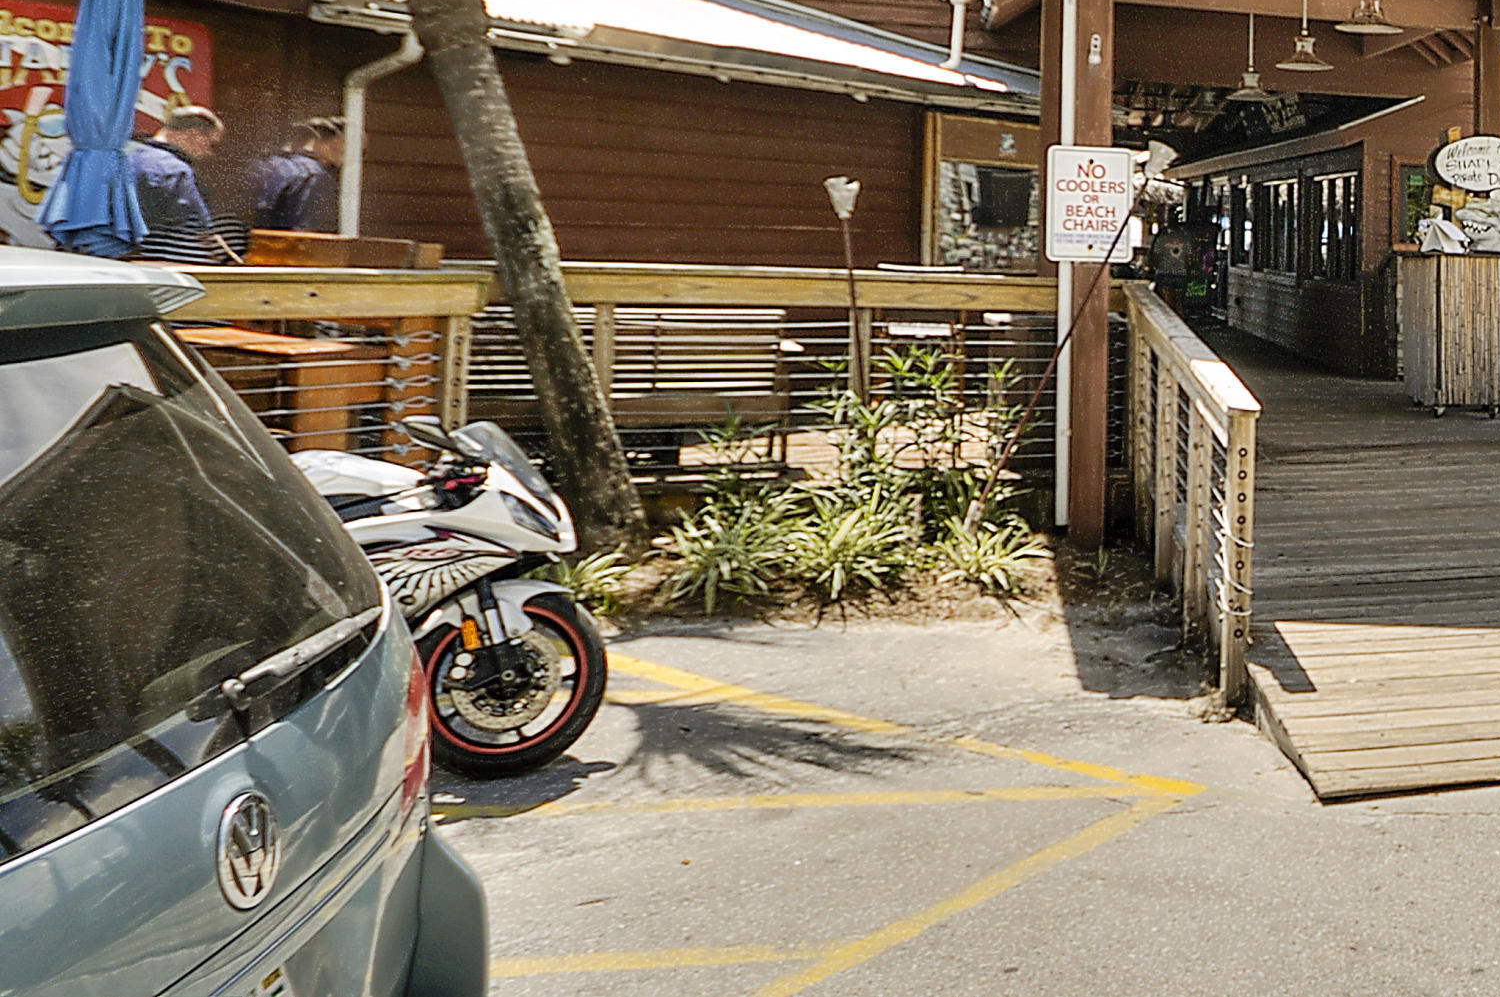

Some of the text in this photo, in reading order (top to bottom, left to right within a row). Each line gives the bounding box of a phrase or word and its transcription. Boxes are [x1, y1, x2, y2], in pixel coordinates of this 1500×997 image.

[1077, 164, 1106, 179] NO
[1056, 179, 1126, 194] COOLERS
[1082, 194, 1099, 204] OR
[1065, 205, 1116, 218] BEACH
[1062, 218, 1118, 232] CHAIRS
